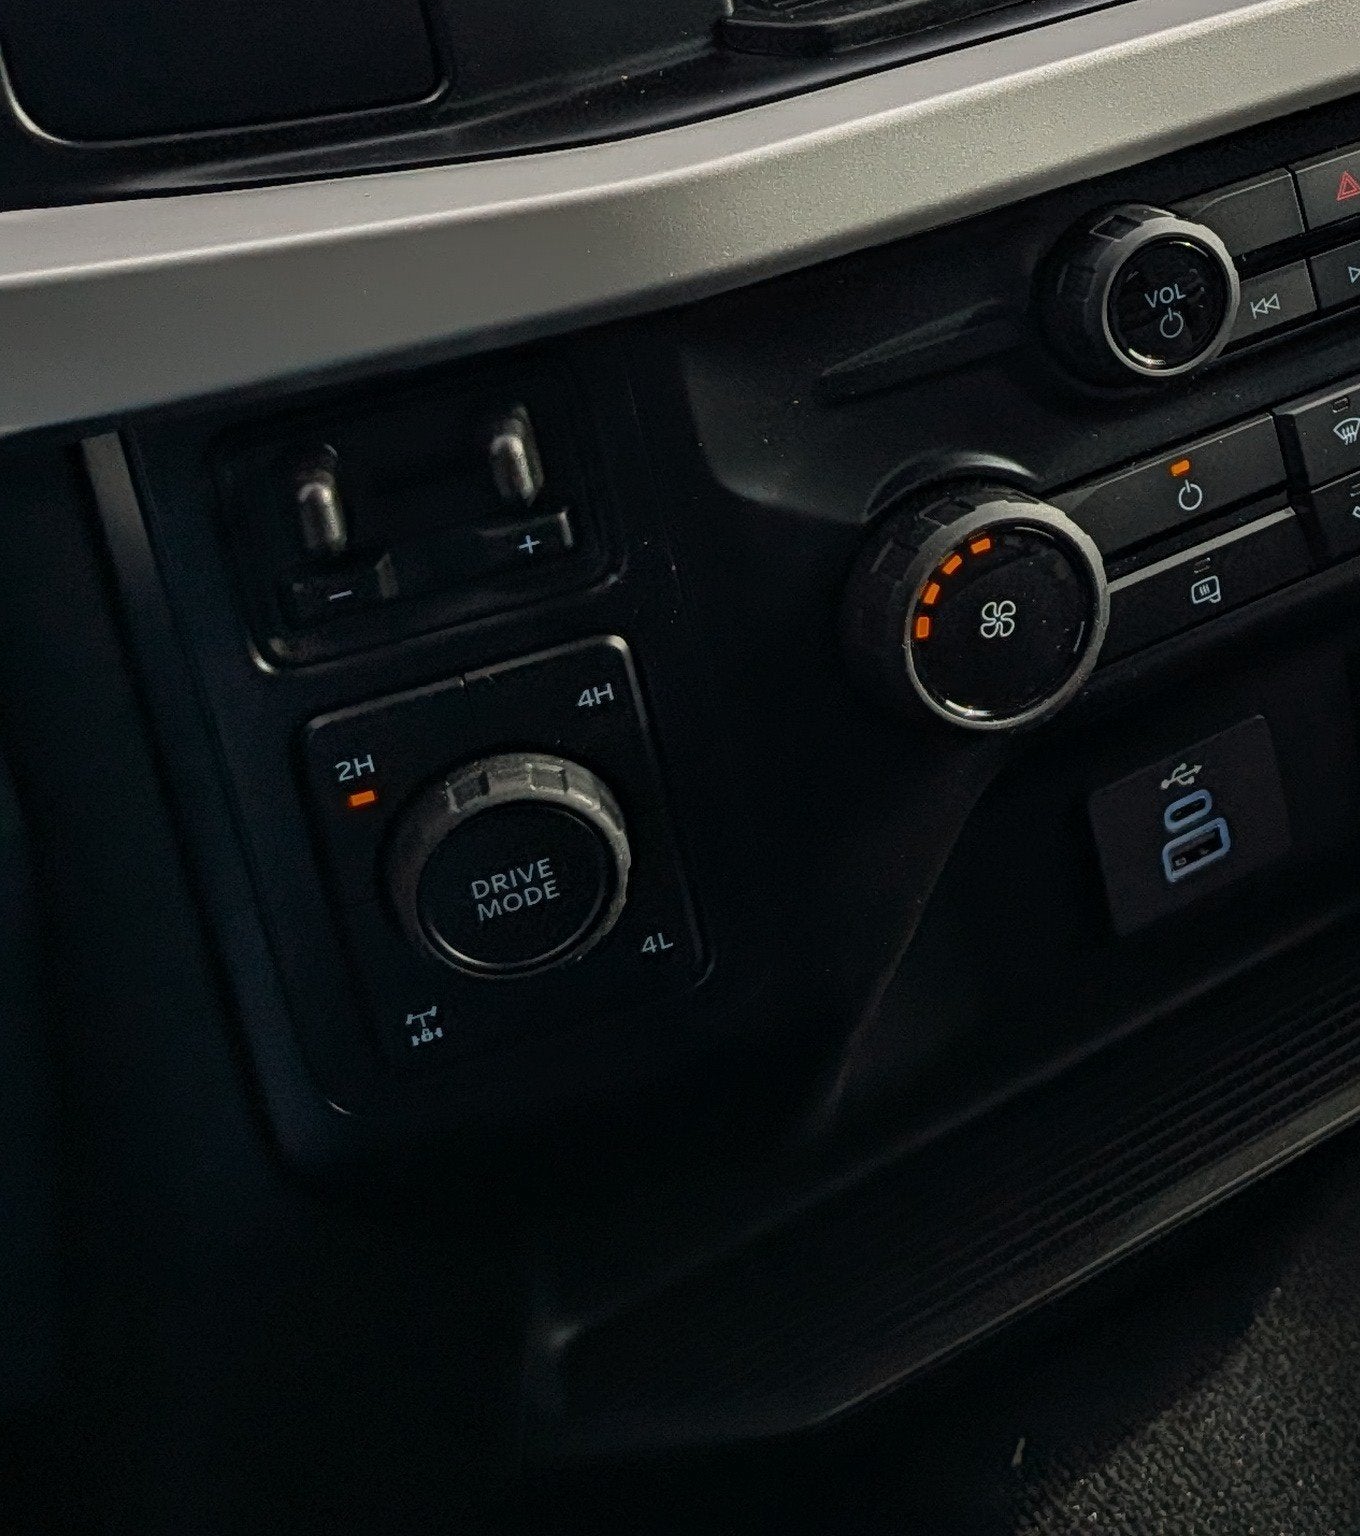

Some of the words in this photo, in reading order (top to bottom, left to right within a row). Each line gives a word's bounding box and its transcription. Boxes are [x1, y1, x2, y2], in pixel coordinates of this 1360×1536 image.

[1144, 283, 1187, 308] VOL
[577, 683, 615, 707] 4H
[335, 754, 375, 782] 2H
[471, 858, 554, 900] DRIVE
[477, 879, 560, 921] MODE
[641, 932, 673, 954] 4L
